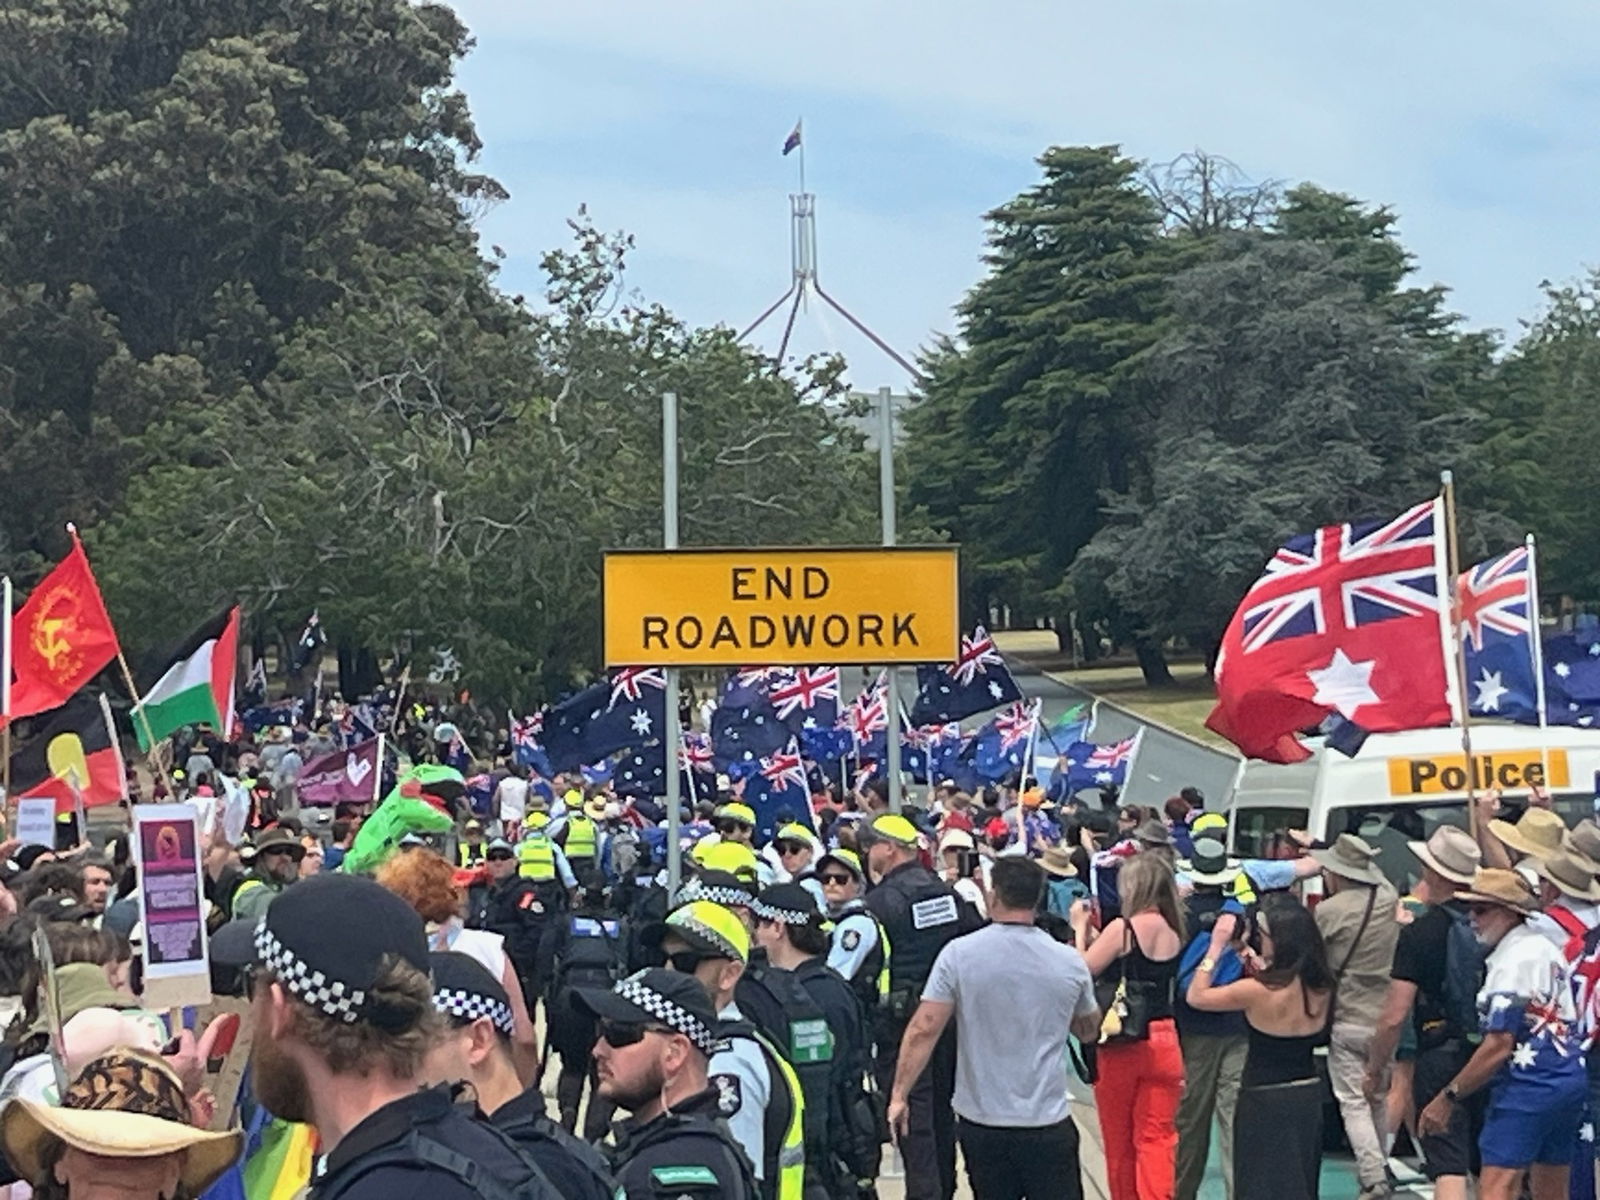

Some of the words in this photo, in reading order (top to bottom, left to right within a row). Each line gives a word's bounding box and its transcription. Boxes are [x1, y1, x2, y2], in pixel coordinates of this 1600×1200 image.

[732, 567, 829, 600] END
[643, 613, 919, 649] ROADWORK
[1410, 755, 1546, 793] Police
